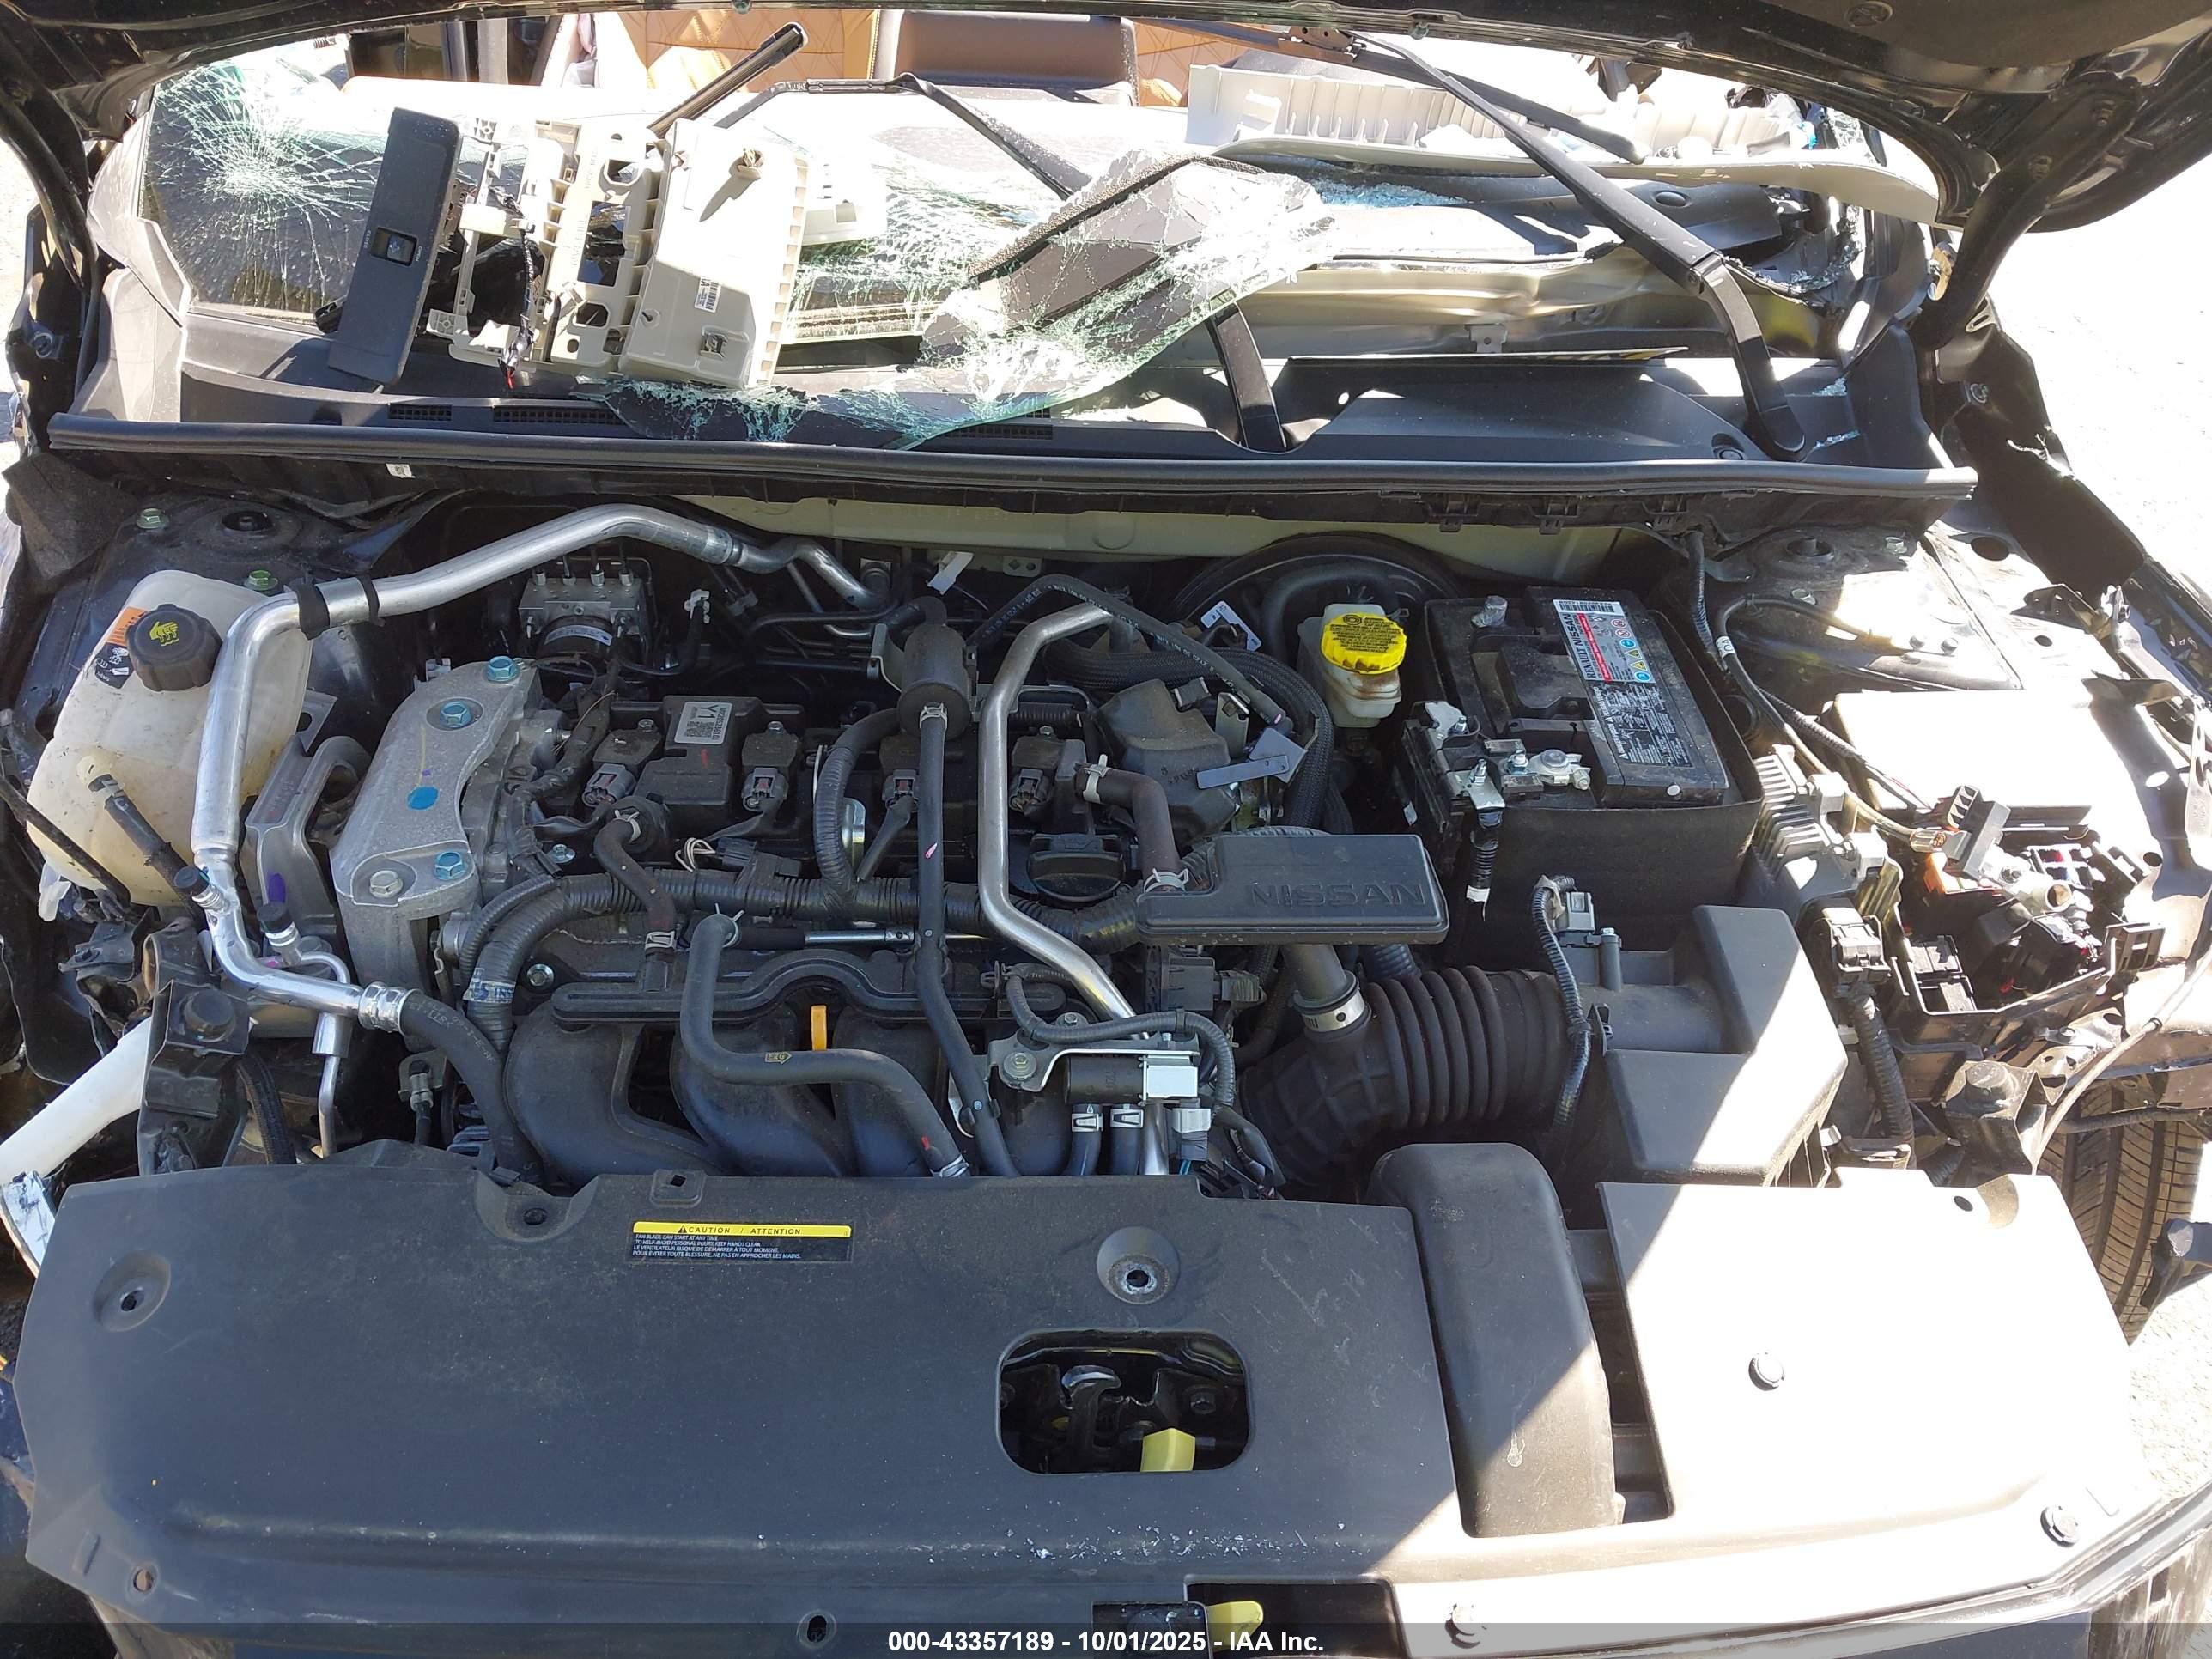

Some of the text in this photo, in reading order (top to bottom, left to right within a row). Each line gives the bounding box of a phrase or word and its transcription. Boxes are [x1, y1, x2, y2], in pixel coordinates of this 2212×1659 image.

[363, 229, 372, 249] CLOSE
[1562, 612, 1583, 646] NISSAN
[1576, 646, 1597, 678] RENAULT
[697, 704, 719, 719] Y1
[1250, 883, 1426, 907] NISSAN
